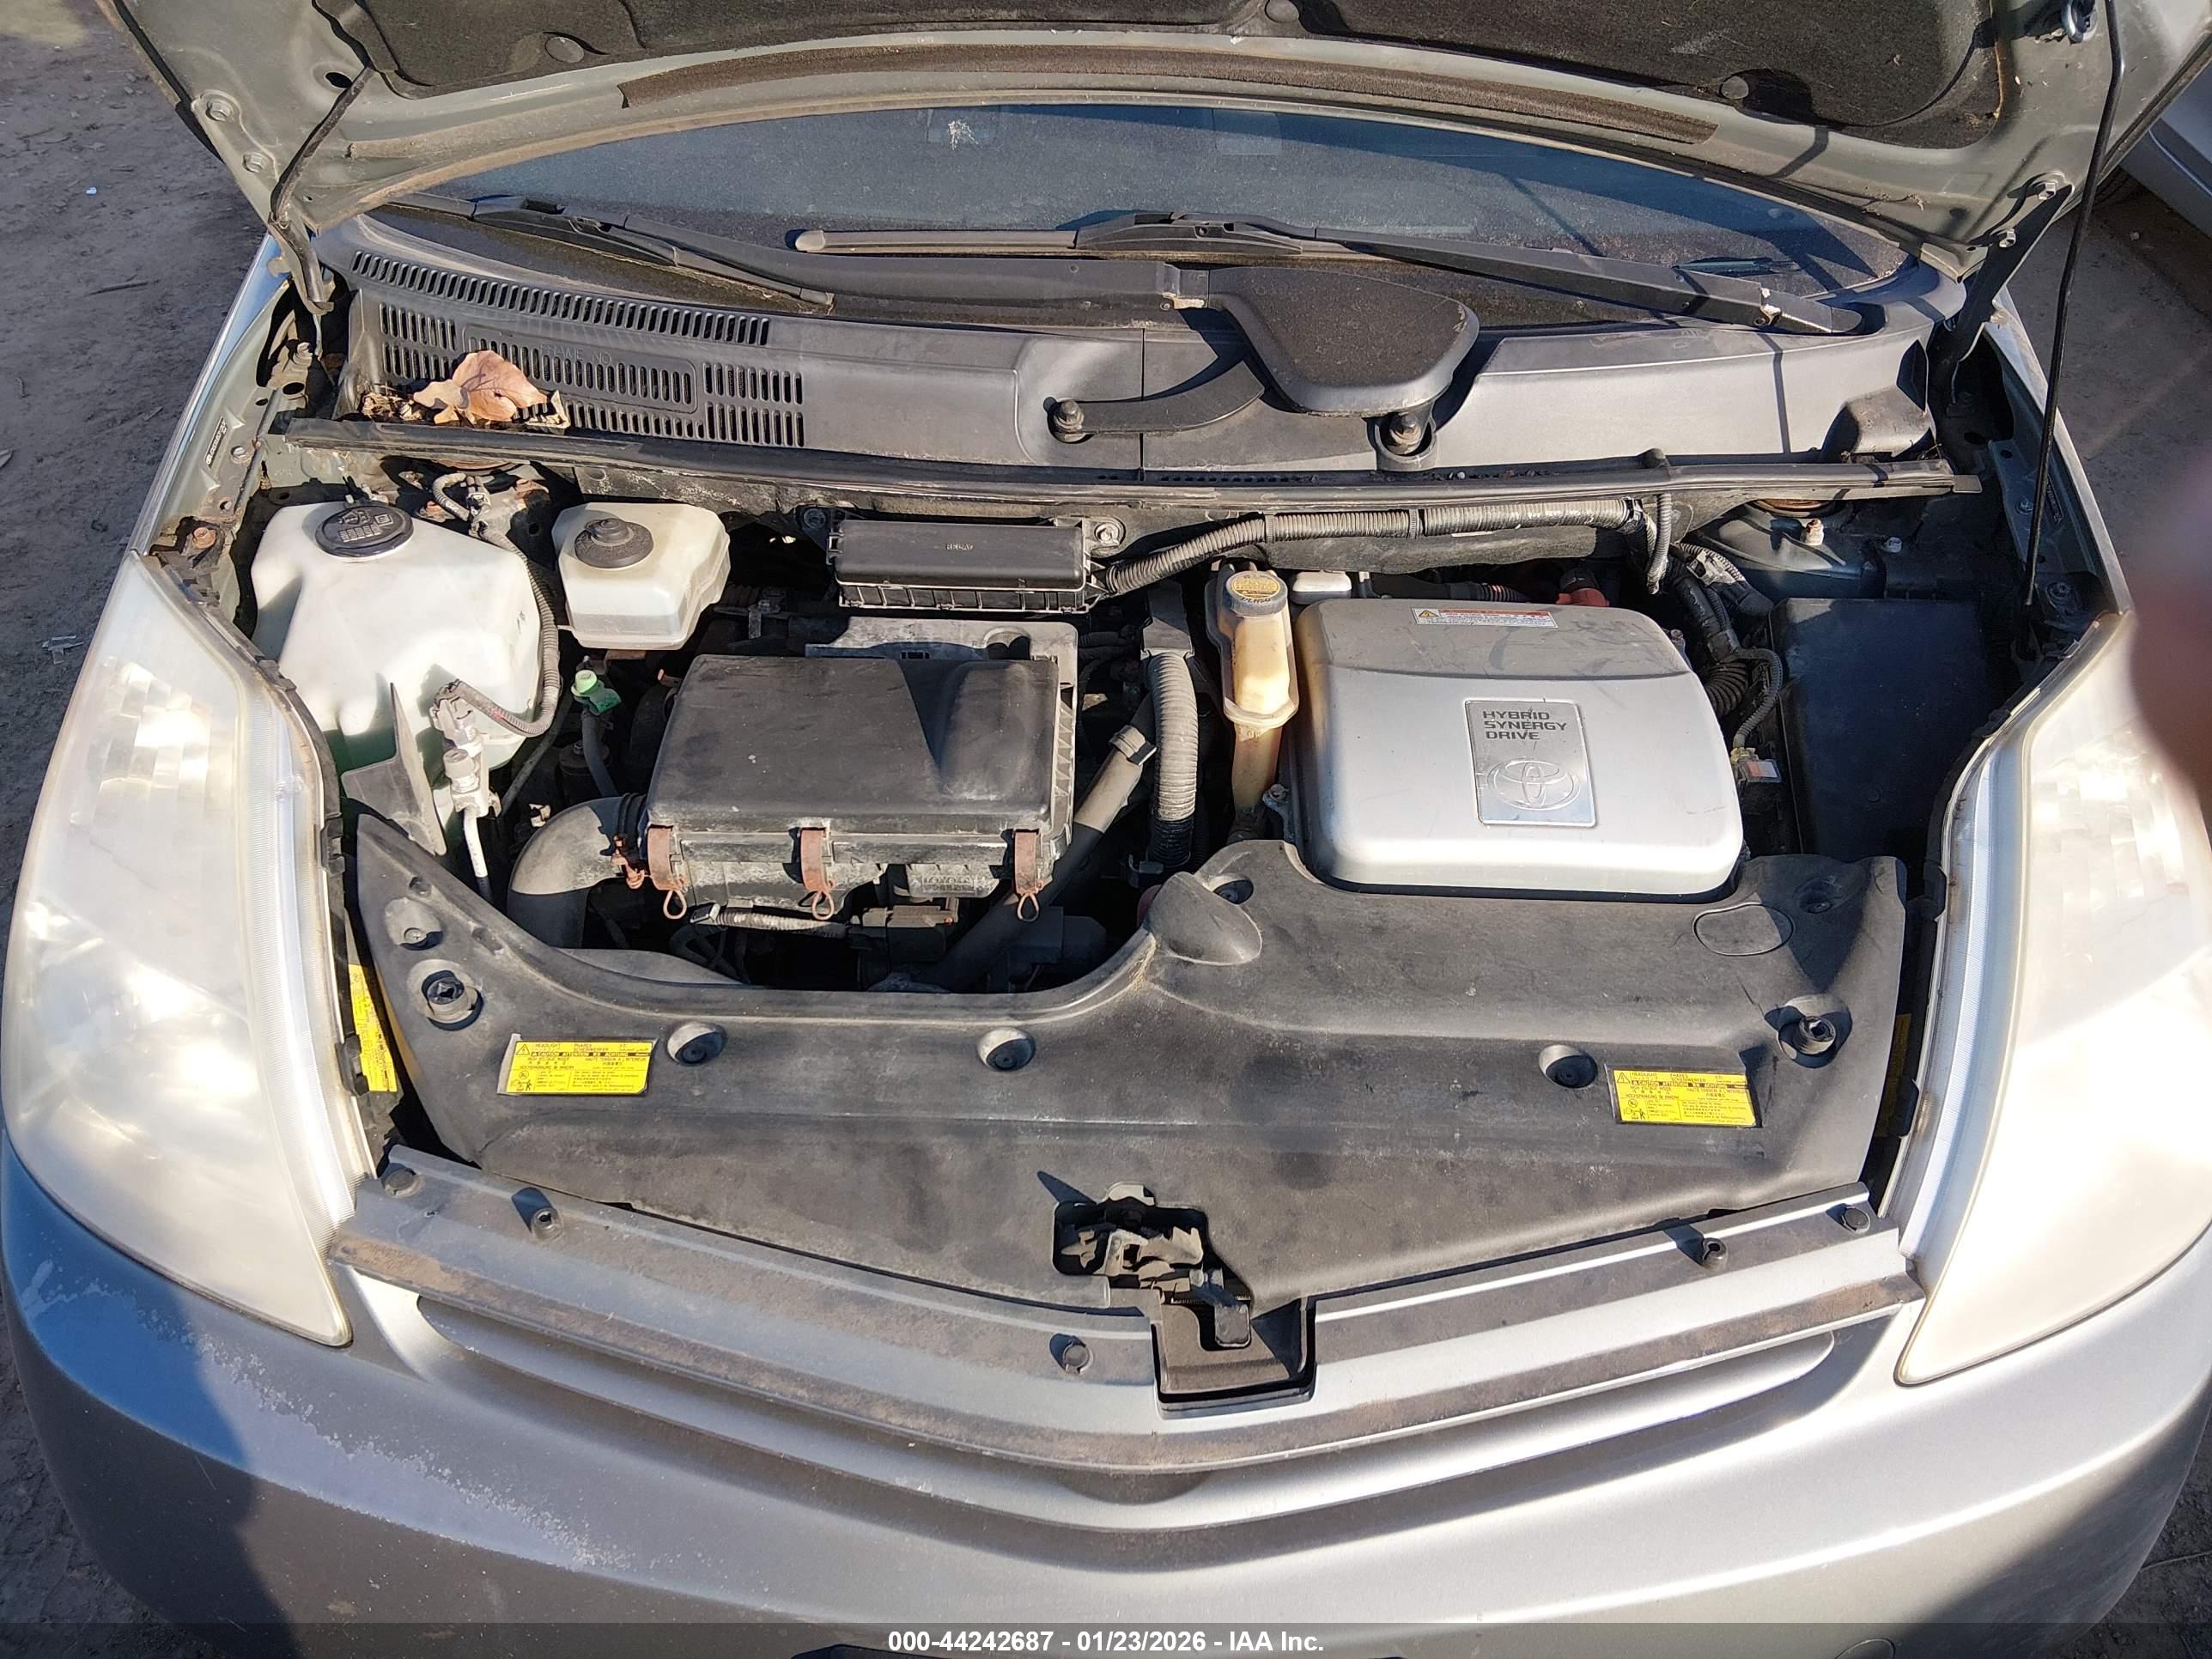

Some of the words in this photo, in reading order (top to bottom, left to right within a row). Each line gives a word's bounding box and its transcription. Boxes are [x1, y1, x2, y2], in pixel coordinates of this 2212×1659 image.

[540, 343, 584, 361] FRAME
[1483, 711, 1550, 720] HYBRID
[1484, 720, 1567, 731] SYNERGY
[1486, 731, 1540, 740] DRIVE
